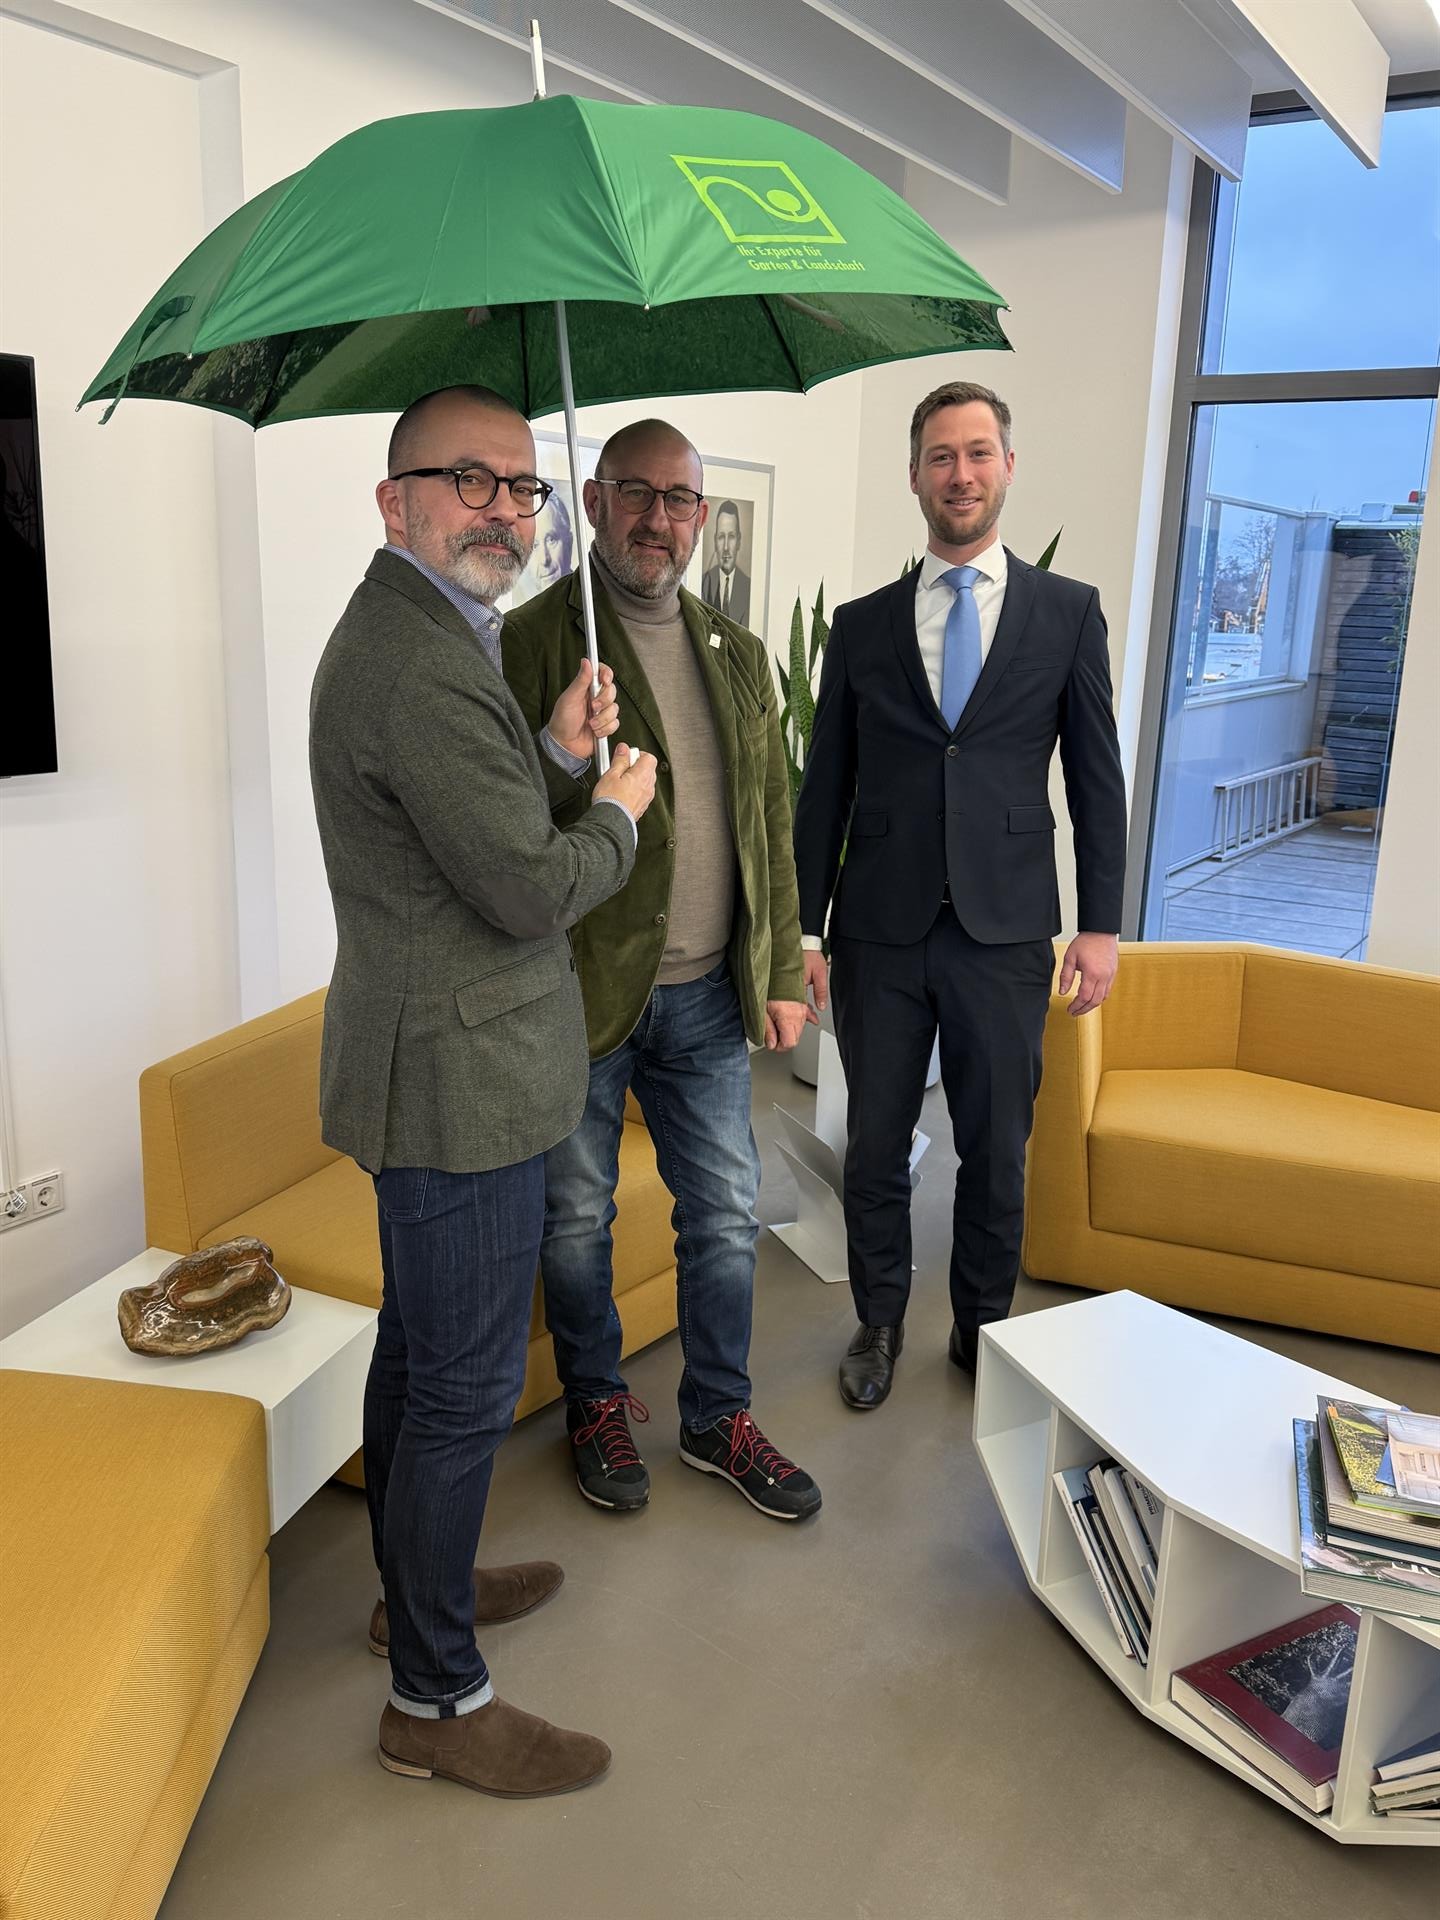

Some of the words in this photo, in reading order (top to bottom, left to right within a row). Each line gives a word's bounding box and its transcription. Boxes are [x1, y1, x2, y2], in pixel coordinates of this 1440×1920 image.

[736, 245, 756, 257] Ihr
[755, 246, 803, 258] Experte
[802, 245, 823, 257] für
[747, 259, 792, 271] Garten
[790, 259, 804, 270] &
[802, 258, 865, 271] Landschaft
